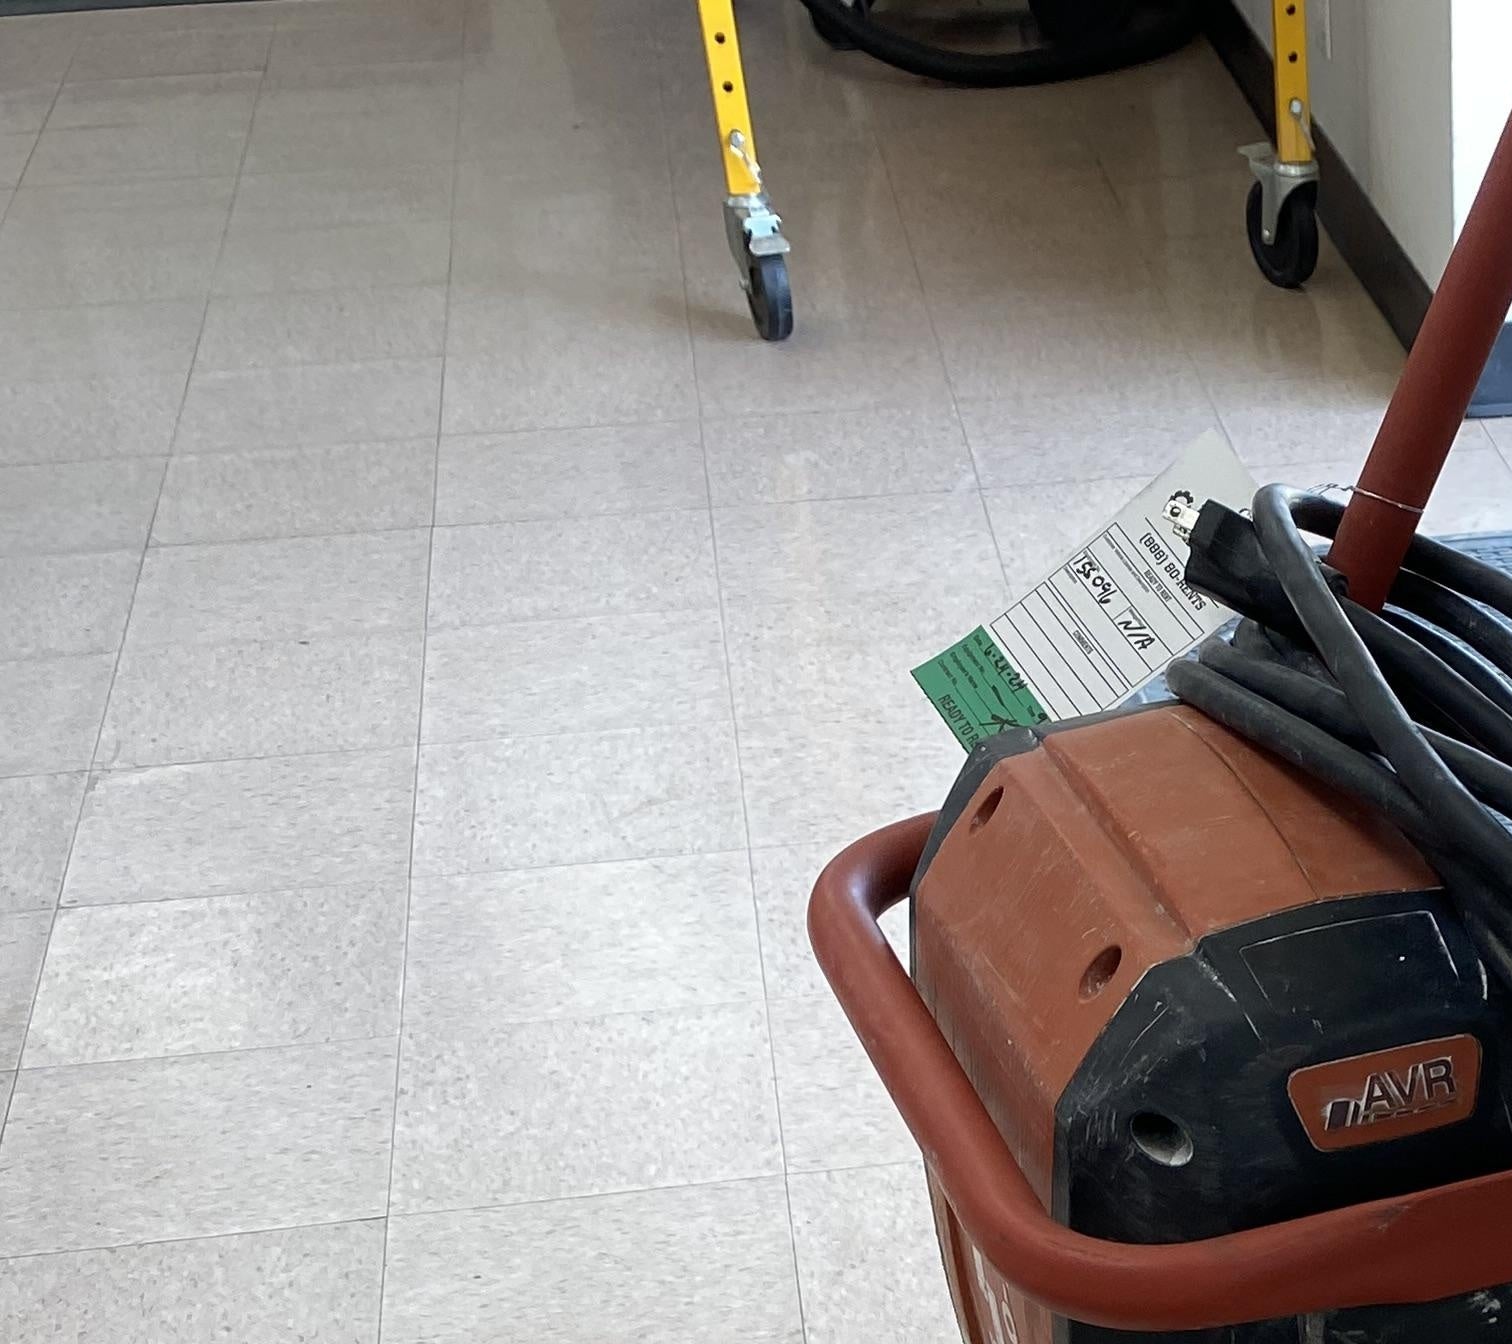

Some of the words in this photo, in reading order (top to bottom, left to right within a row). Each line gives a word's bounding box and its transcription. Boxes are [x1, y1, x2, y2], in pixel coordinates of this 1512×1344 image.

[1073, 554, 1118, 605] 155096
[1139, 532, 1169, 566] (888)
[1164, 562, 1206, 611] 80-RENTS
[1143, 569, 1158, 586] READY
[1159, 589, 1172, 602] RENT
[1118, 620, 1156, 650] N/A
[938, 694, 964, 723] READY
[959, 722, 975, 737] TO
[1363, 1056, 1457, 1114] AVR
